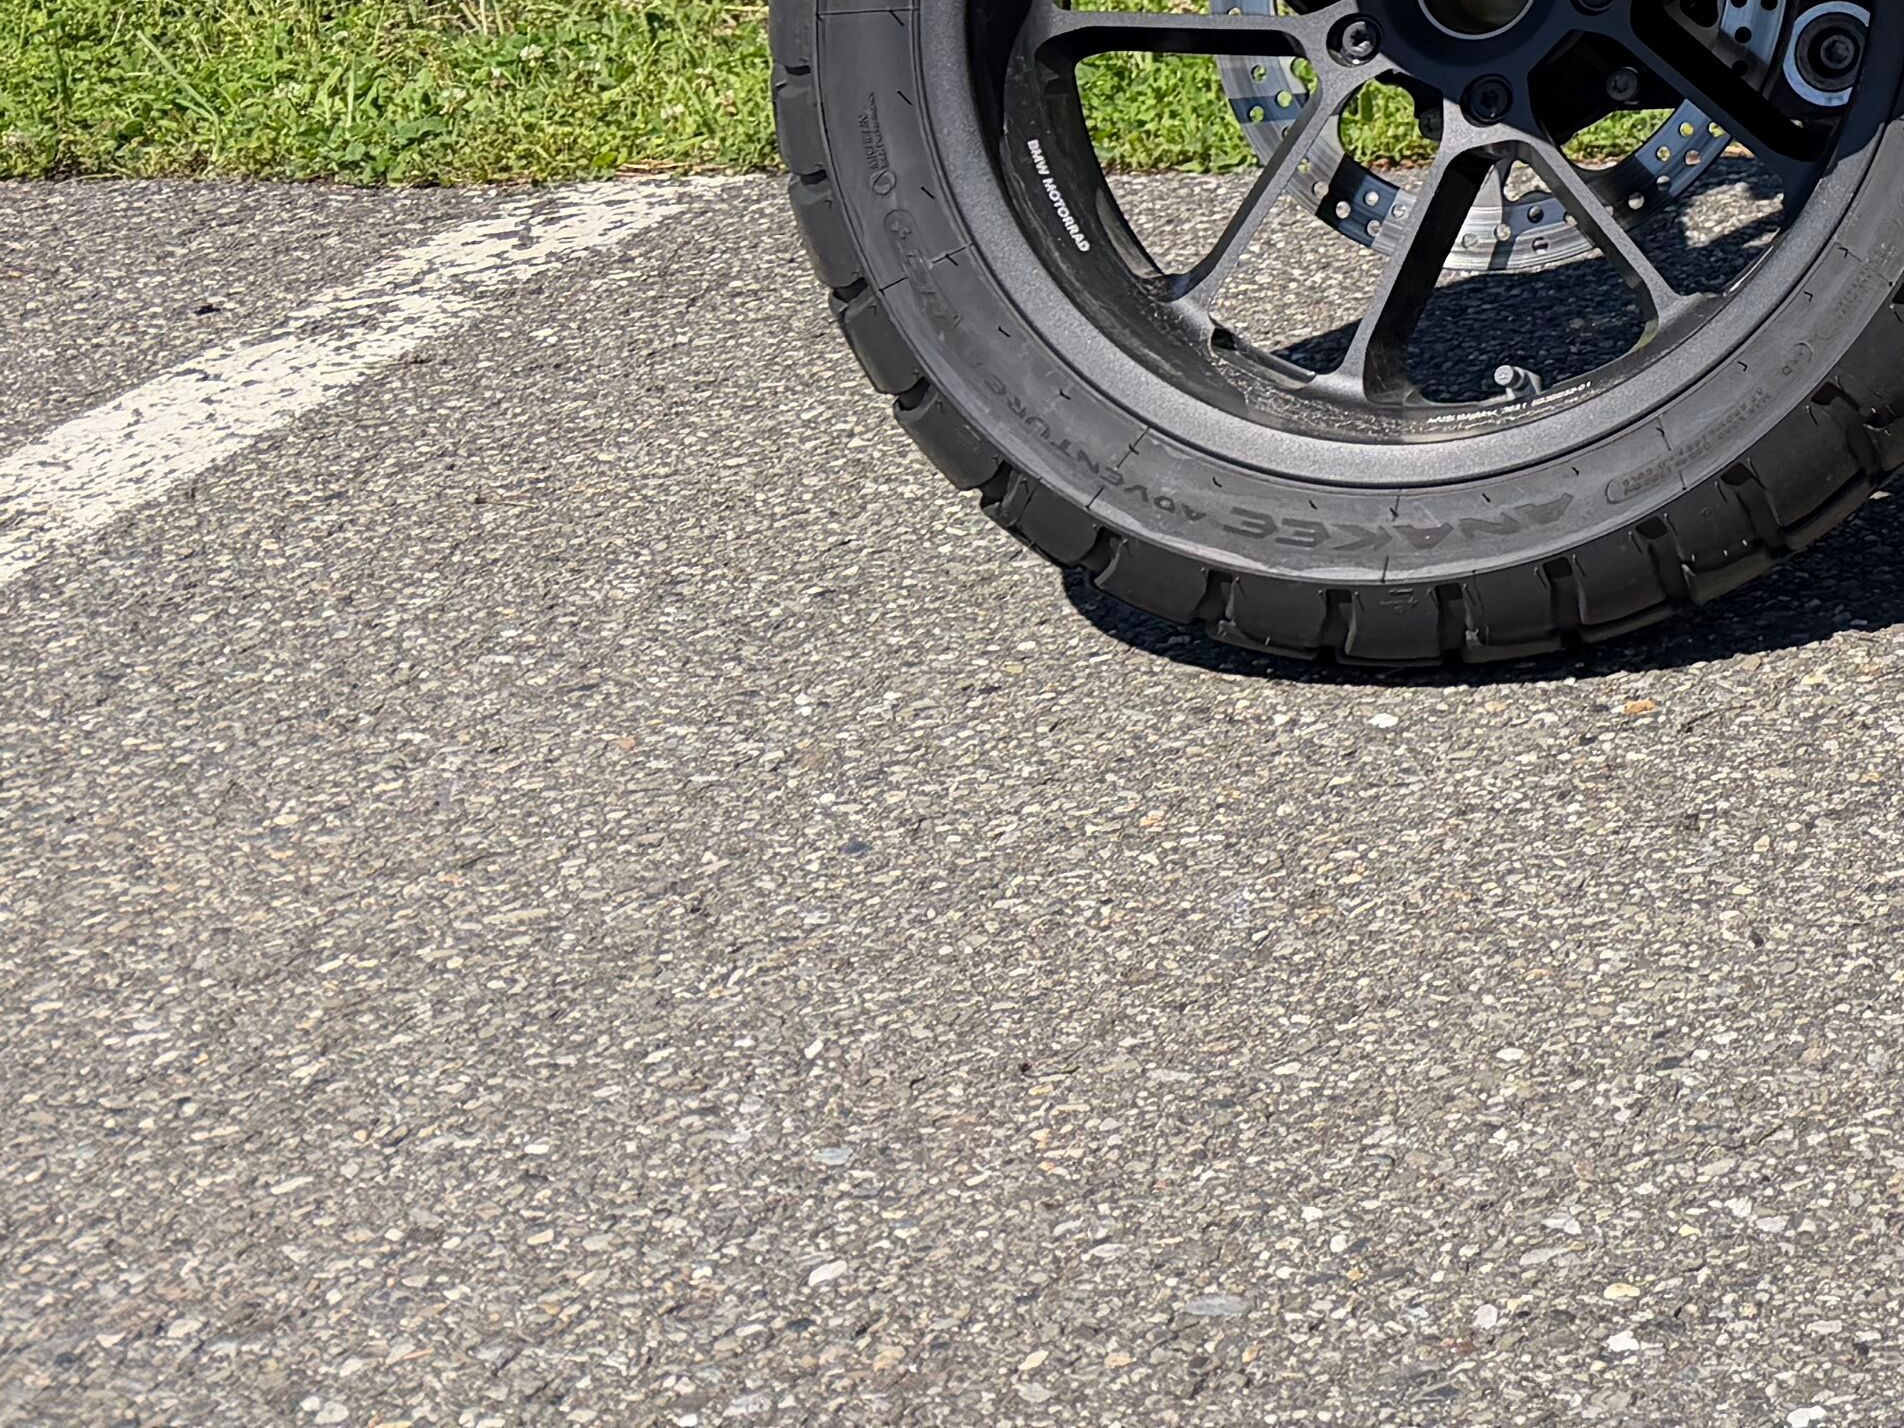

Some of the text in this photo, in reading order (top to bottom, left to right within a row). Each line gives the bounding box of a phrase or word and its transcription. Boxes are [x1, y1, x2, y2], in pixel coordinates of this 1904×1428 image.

[1027, 139, 1091, 253] BMW MOTORRAD
[984, 376, 1575, 551] ANAKEE ADVENTURE
